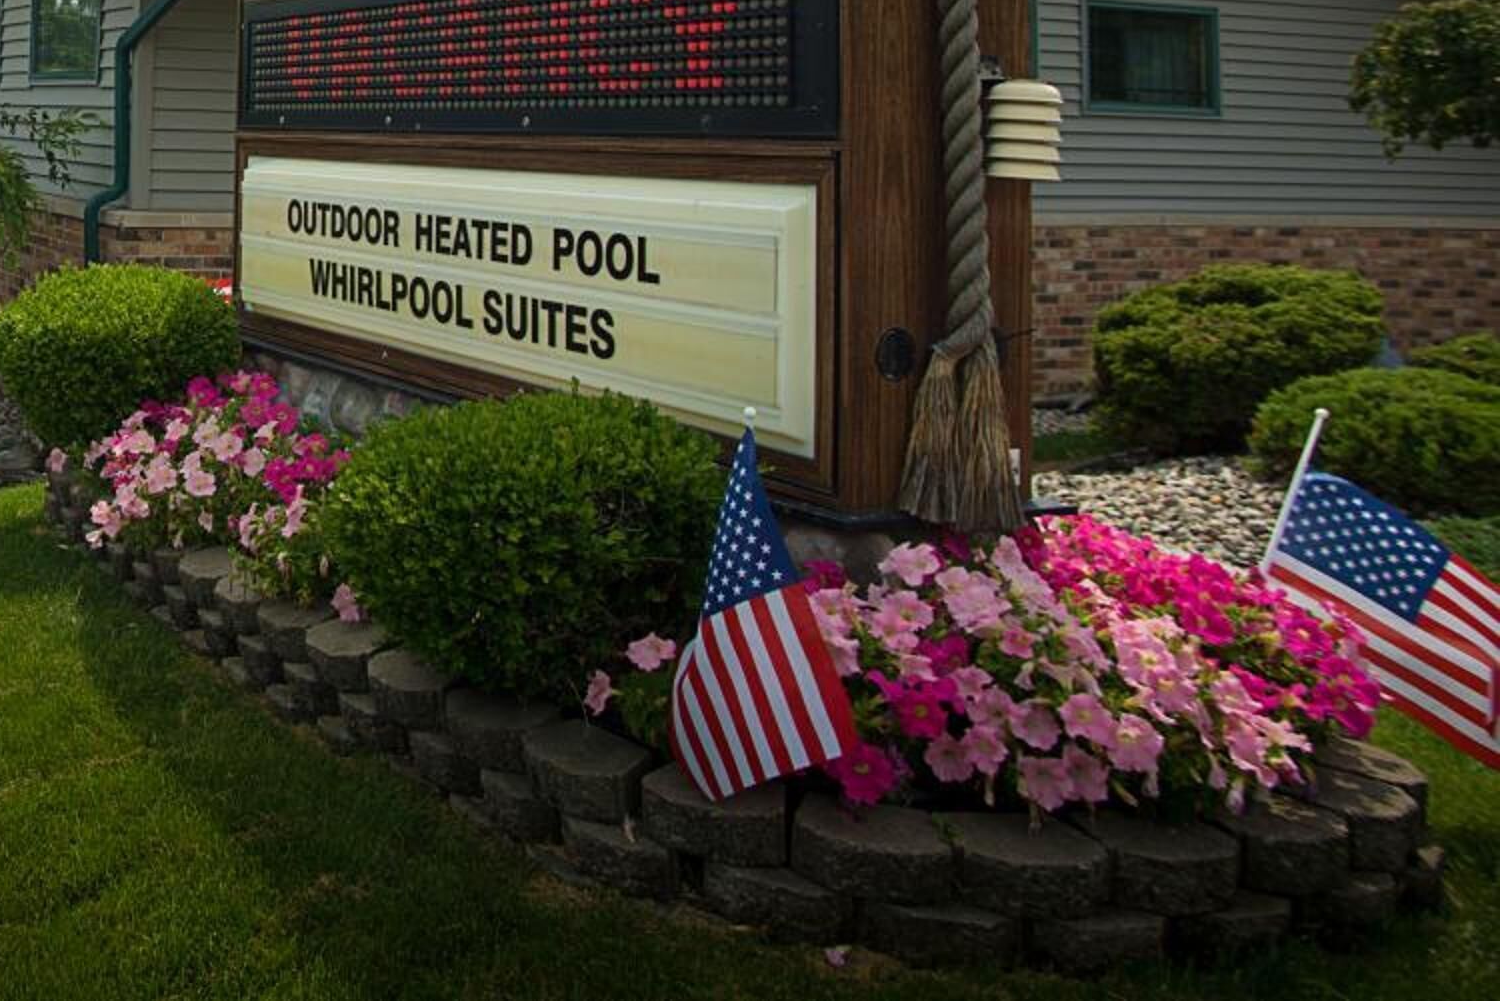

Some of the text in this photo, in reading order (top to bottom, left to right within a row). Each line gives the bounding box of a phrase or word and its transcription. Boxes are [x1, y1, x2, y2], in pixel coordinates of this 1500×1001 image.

[287, 199, 660, 284] OUTDOOR HEATED POOL
[310, 259, 616, 359] WHIRLPOOL SUITES
